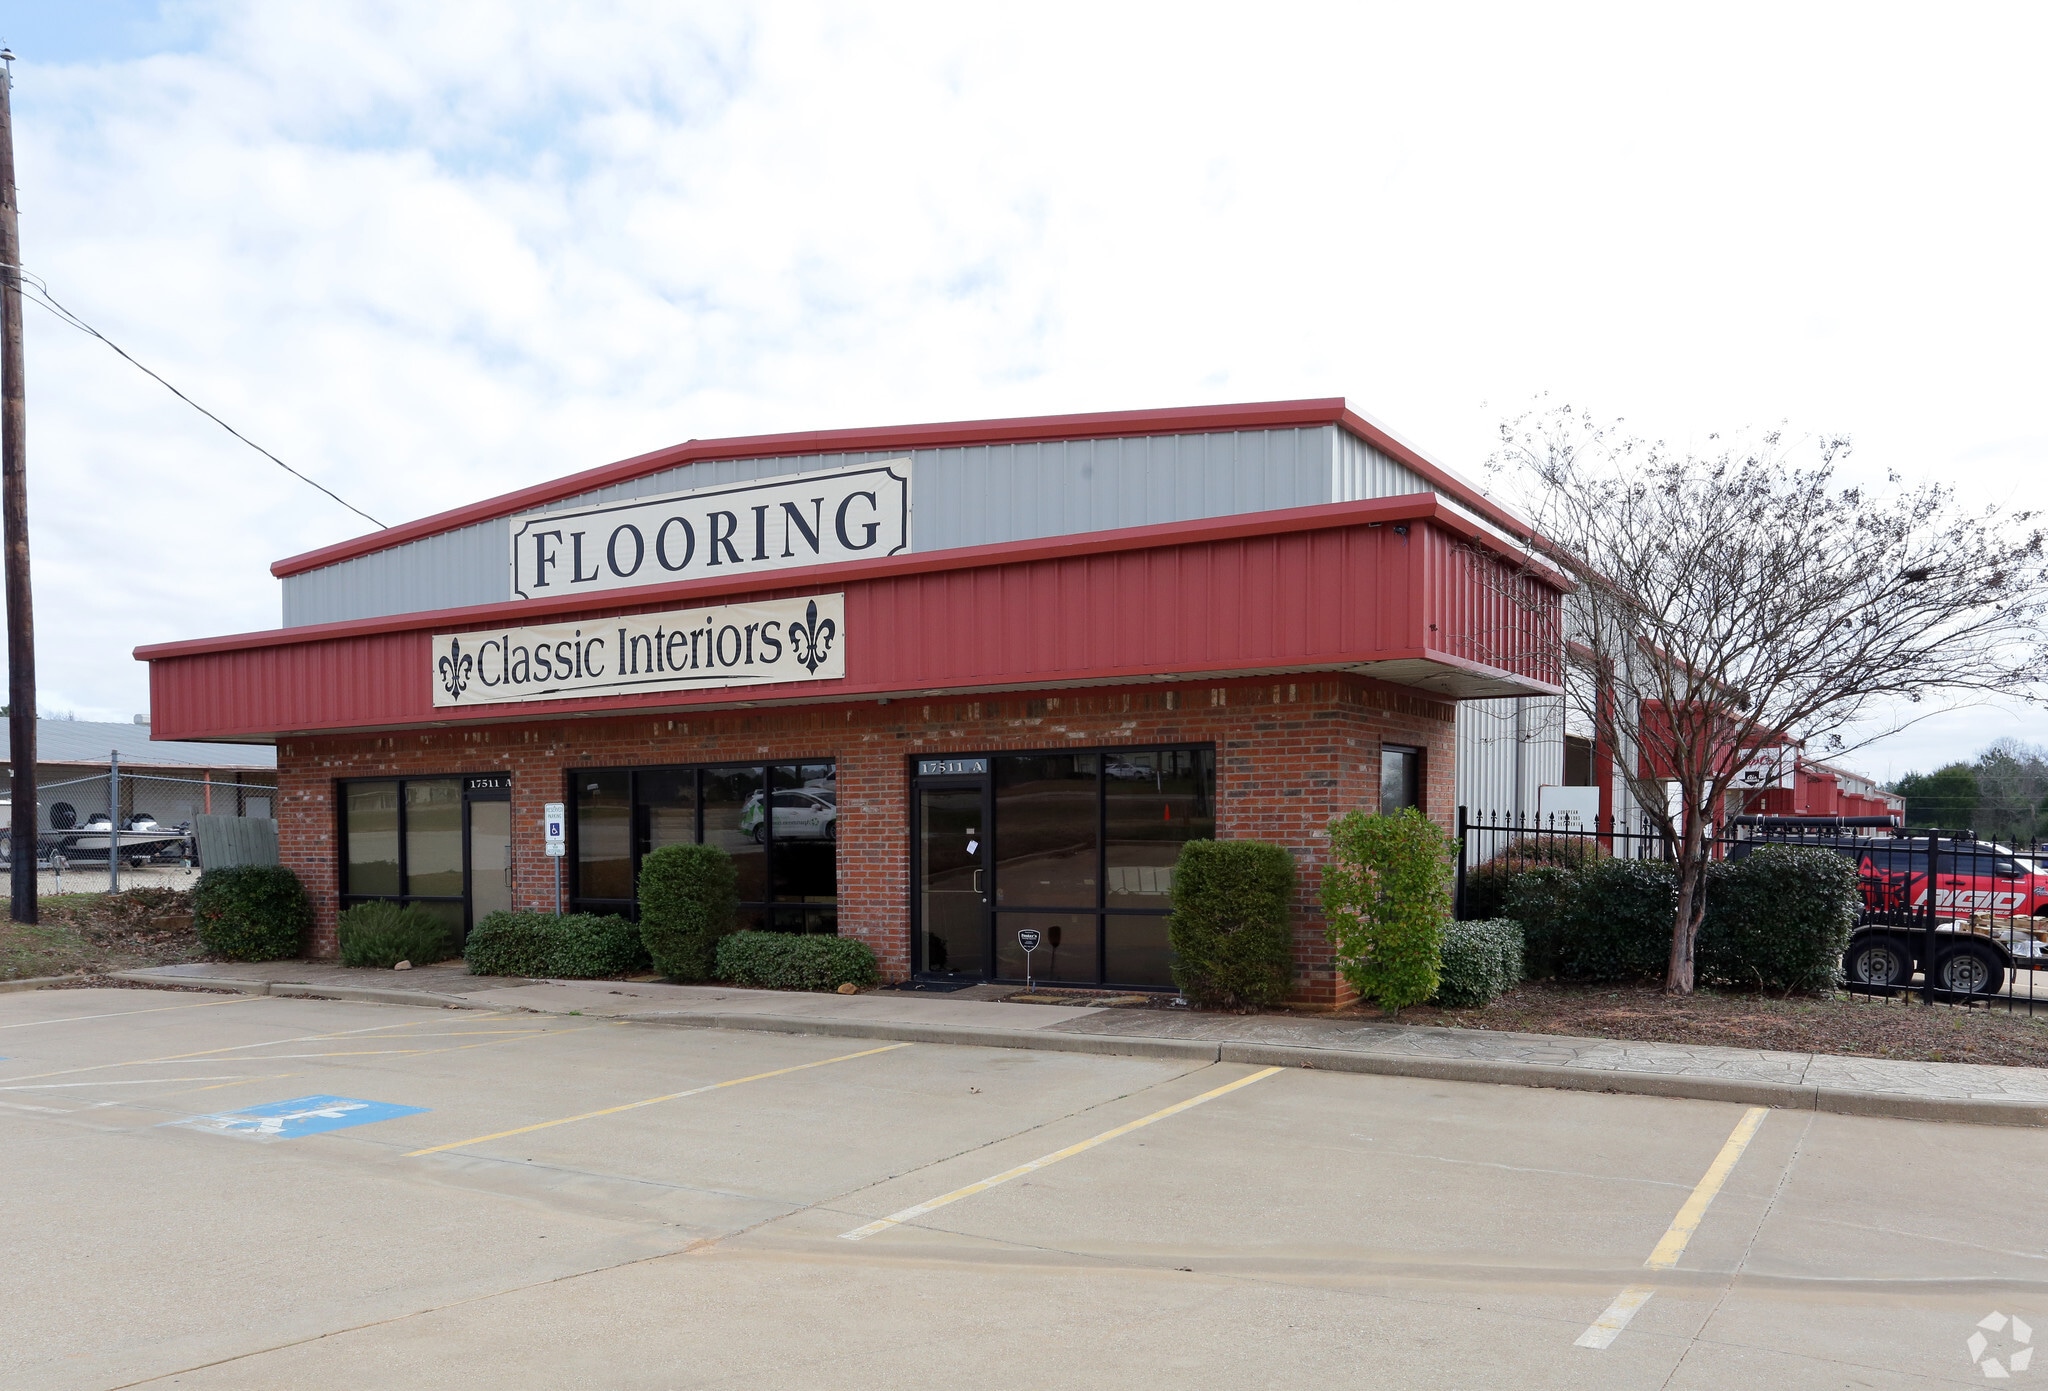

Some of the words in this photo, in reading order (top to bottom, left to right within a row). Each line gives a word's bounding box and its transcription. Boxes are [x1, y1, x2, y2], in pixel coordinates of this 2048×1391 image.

[532, 490, 881, 588] FLOORING
[477, 629, 605, 687] Classic
[617, 615, 782, 675] Interiors
[922, 762, 963, 773] 17511
[972, 761, 982, 771] A
[470, 779, 500, 789] 17511
[505, 778, 512, 787] A
[1914, 888, 2027, 910] RIGID
